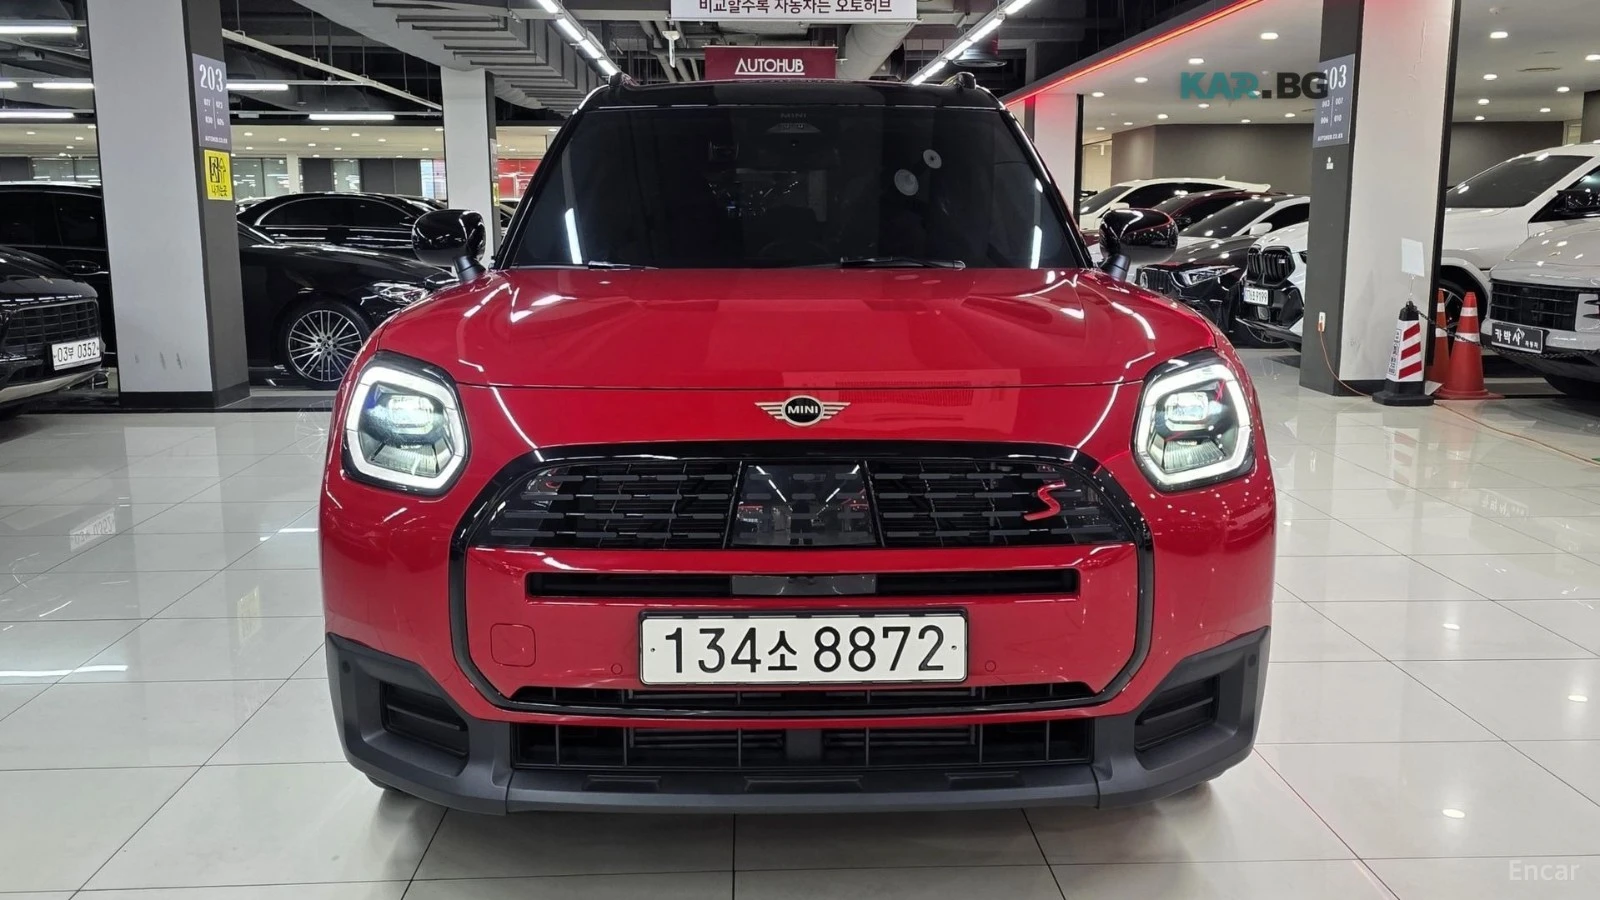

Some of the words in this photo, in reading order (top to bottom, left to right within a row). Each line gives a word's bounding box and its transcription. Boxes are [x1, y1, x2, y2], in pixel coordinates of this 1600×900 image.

[699, 0, 770, 13] 비교할수록
[774, 0, 831, 14] 자동차는
[835, 0, 892, 14] 오토허브
[735, 58, 805, 75] AUTOHUB
[199, 64, 224, 92] 203
[77, 342, 97, 359] 0352
[787, 405, 819, 414] MINI
[1024, 480, 1067, 521] S
[665, 627, 798, 673] 134소
[813, 625, 944, 673] 8872
